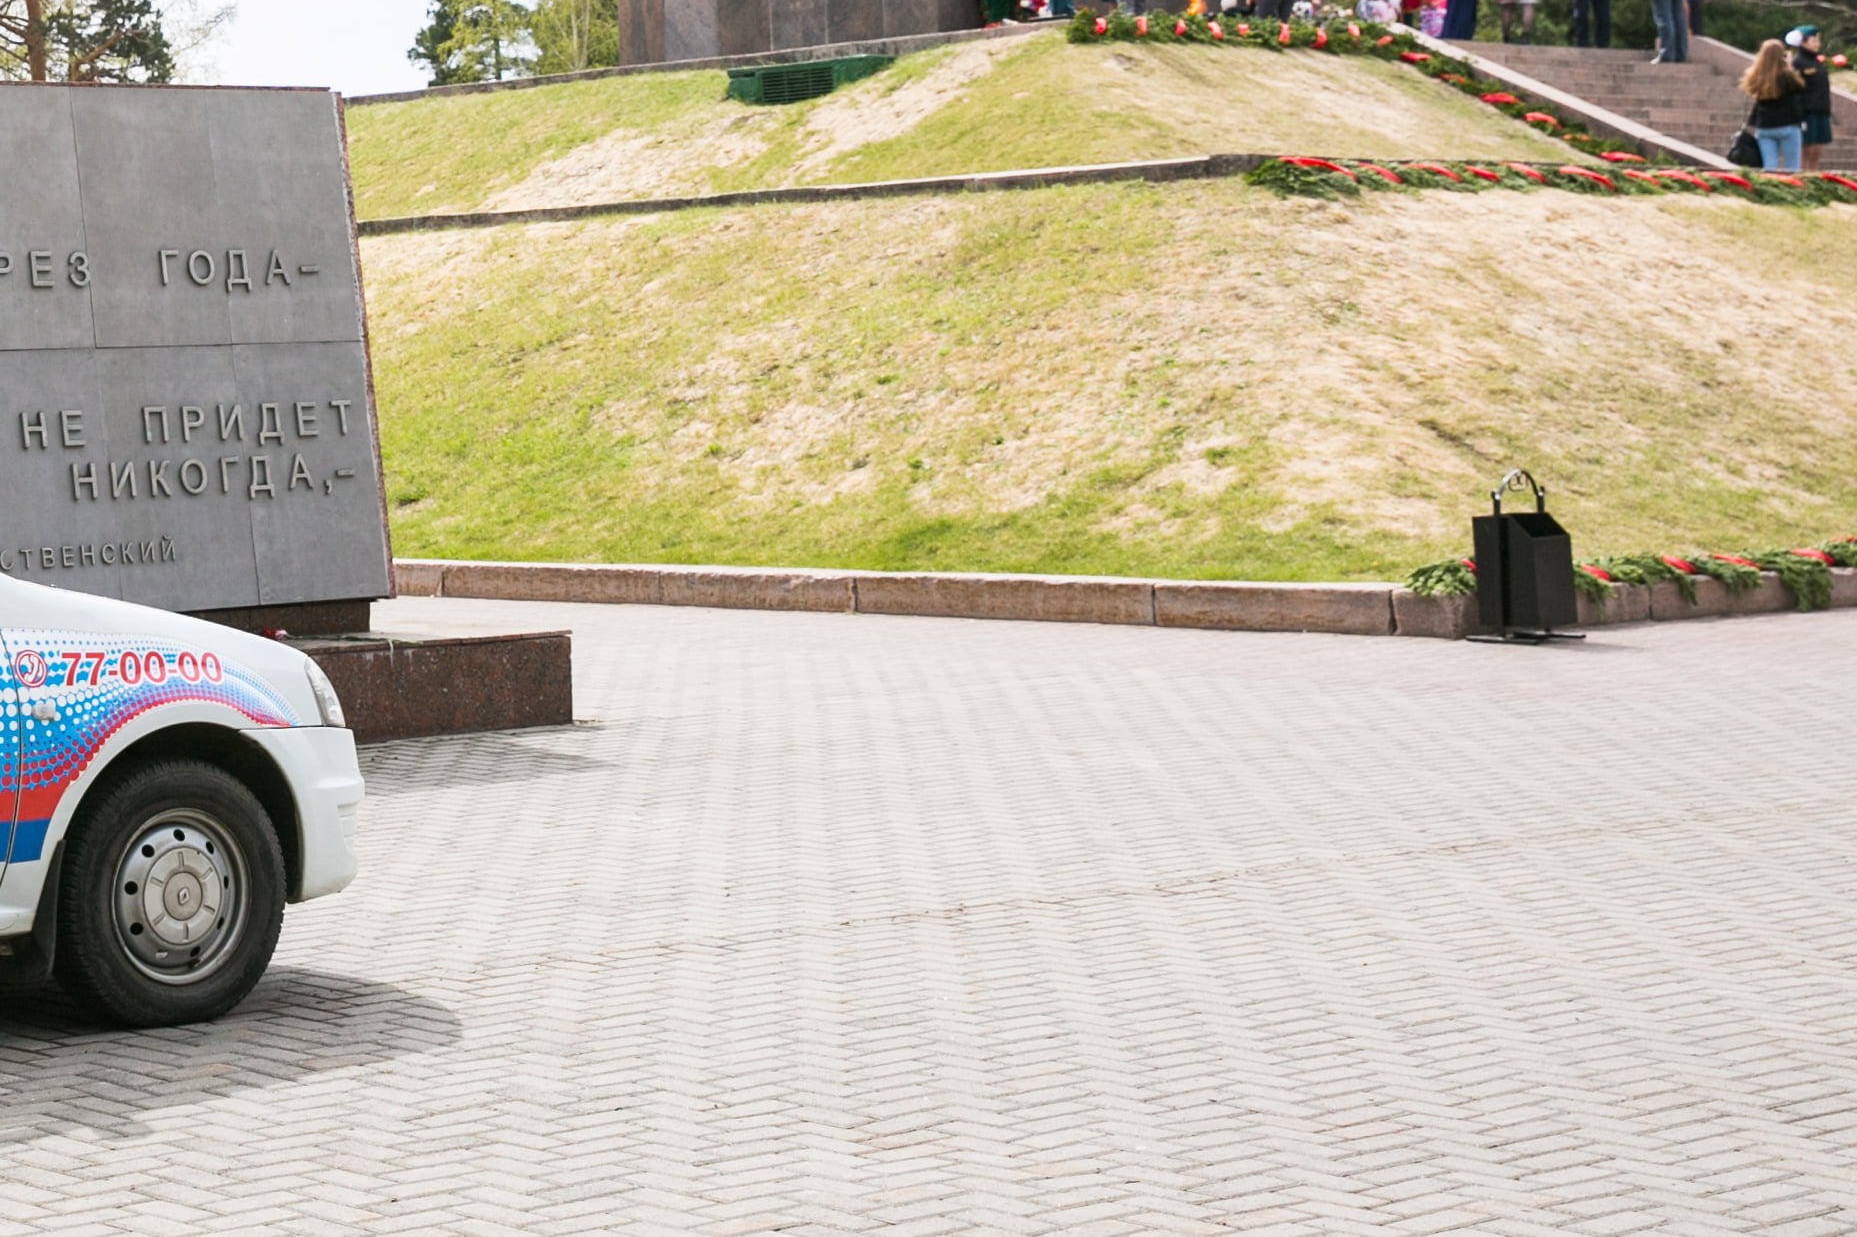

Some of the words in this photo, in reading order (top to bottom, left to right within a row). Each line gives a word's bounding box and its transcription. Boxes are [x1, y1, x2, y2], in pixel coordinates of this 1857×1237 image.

[20, 409, 85, 449] НЕ
[141, 398, 352, 446] ПРИДЕТ
[61, 651, 223, 687] 77-00-00
